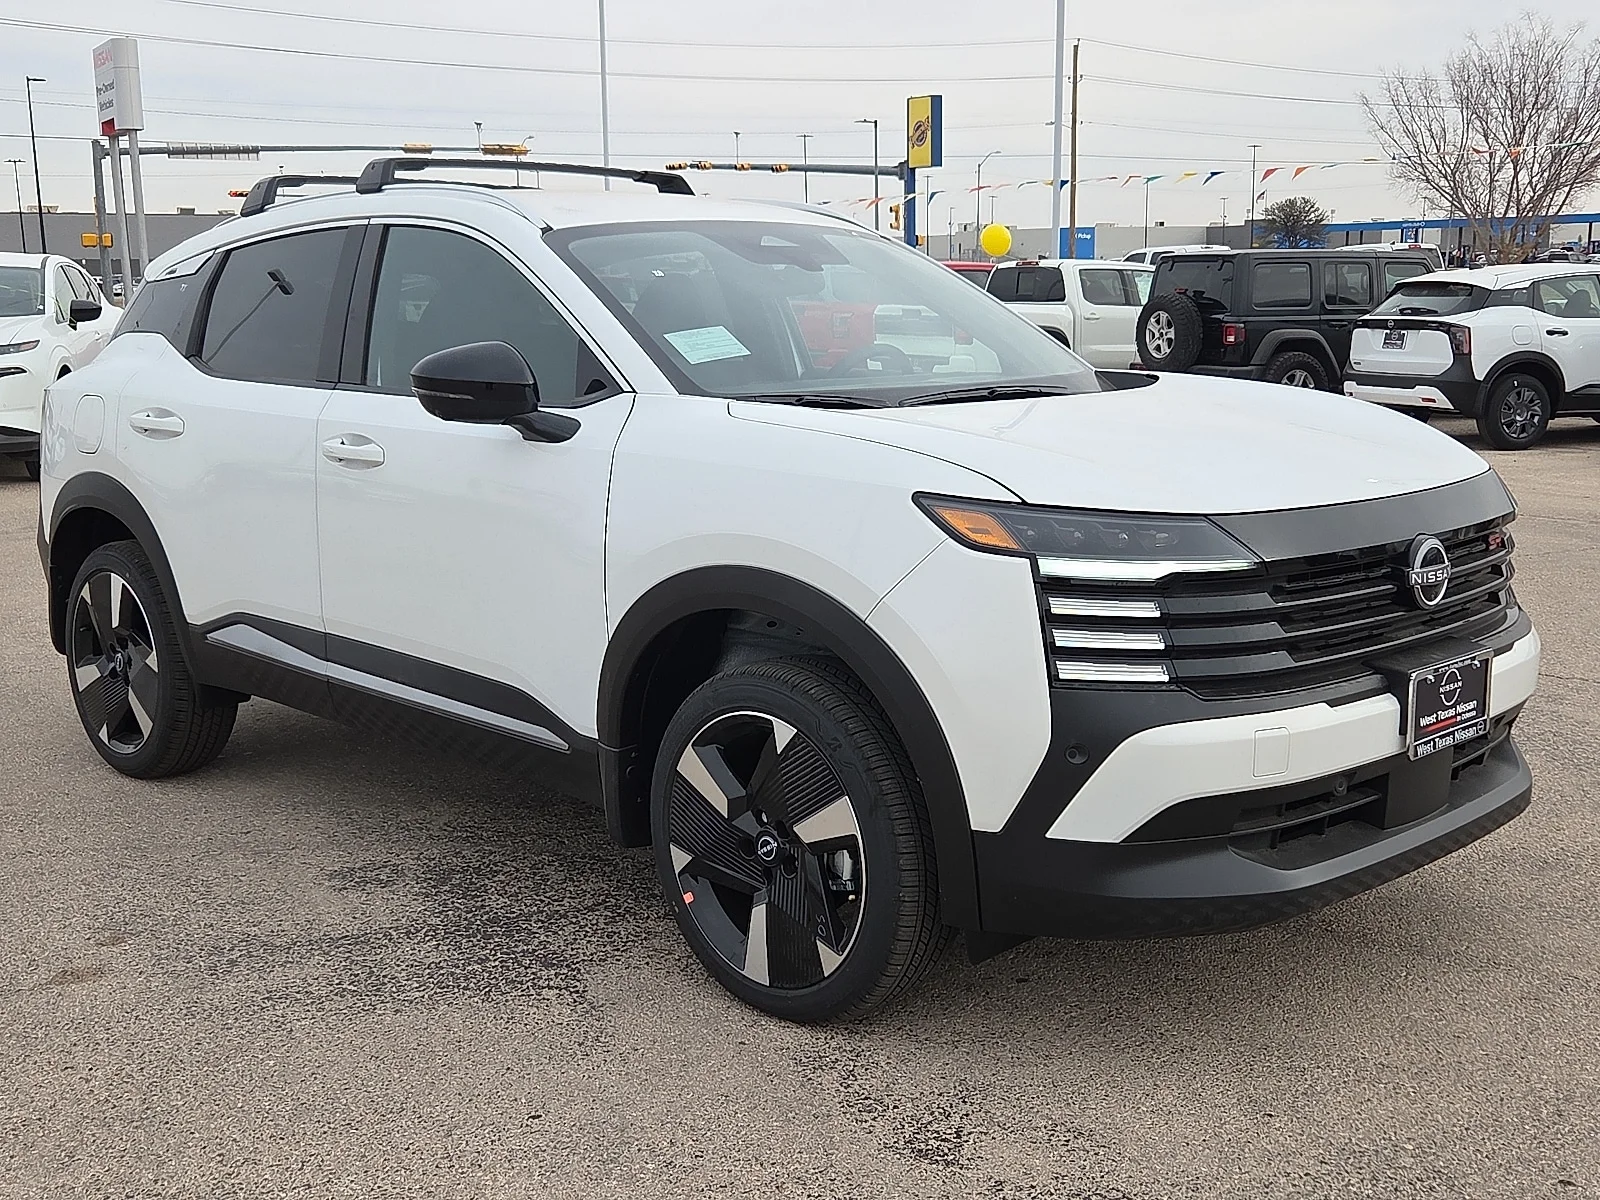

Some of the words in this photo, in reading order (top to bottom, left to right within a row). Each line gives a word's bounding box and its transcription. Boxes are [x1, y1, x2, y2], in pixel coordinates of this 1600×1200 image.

[1411, 566, 1450, 584] NISSA
[1439, 680, 1463, 693] NISSAN
[1420, 713, 1437, 727] West
[1437, 707, 1456, 719] Texas
[1456, 700, 1478, 714] Nissan
[1417, 742, 1434, 757] West
[1434, 735, 1454, 749] Texas
[1455, 726, 1477, 741] Nissan
